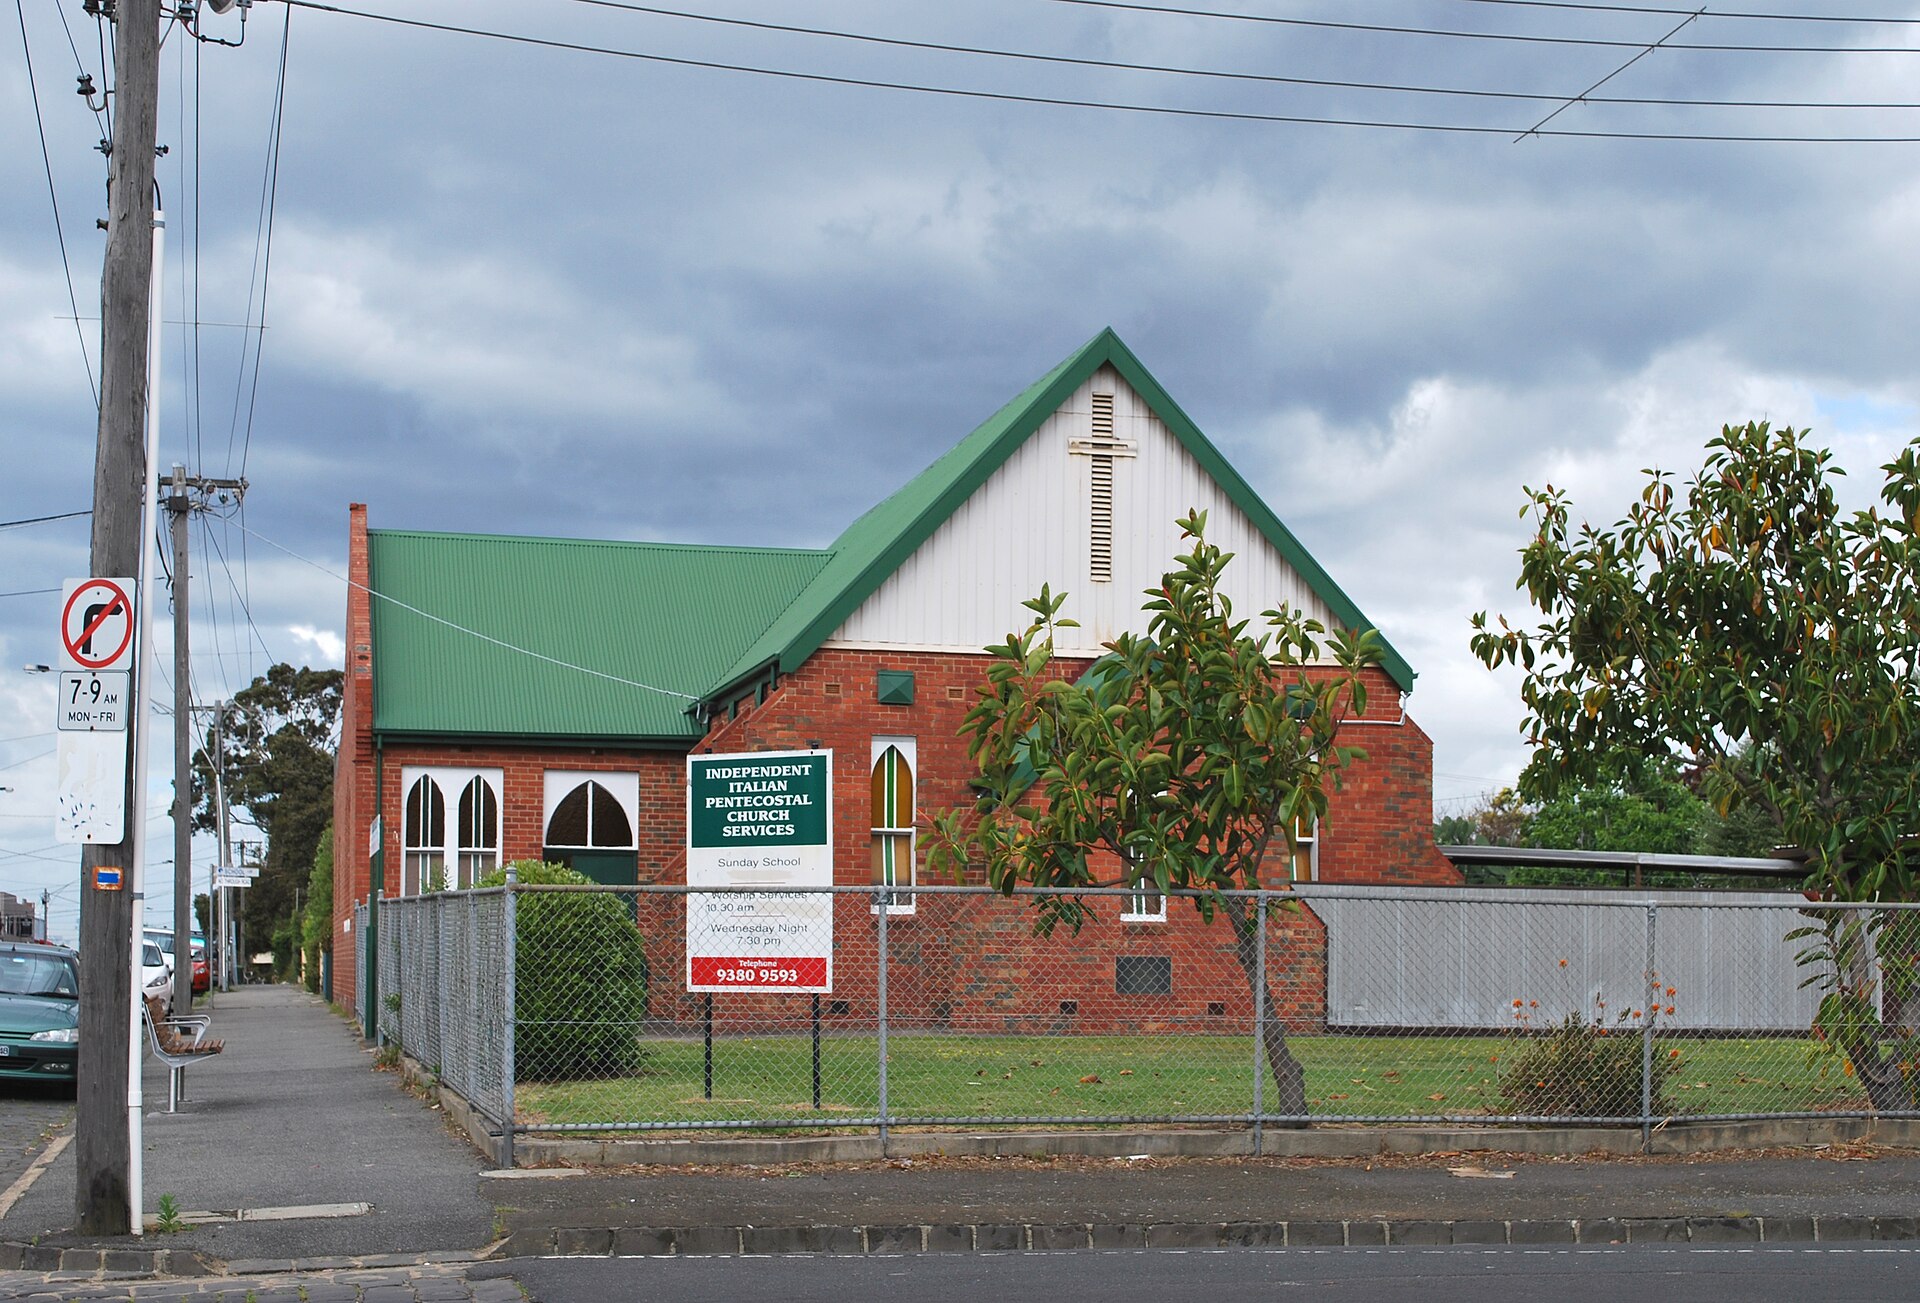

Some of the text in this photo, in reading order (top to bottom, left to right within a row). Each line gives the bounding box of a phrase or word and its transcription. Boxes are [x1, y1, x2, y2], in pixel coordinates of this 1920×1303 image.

[71, 679, 118, 704] 7-9 AM
[705, 765, 812, 779] INDEPENDENT
[729, 780, 788, 793] ITALIAN
[705, 794, 812, 808] PENTECOSTAL
[727, 810, 790, 822] CHURCH
[722, 824, 795, 837] SERVICES
[718, 858, 759, 868] Sunday
[762, 857, 801, 867] School
[712, 891, 808, 900] Worship Services
[710, 924, 808, 934] Wednesday Night
[764, 938, 781, 946] pm
[739, 960, 778, 968] Telephone
[717, 969, 798, 982] 9380 9593
